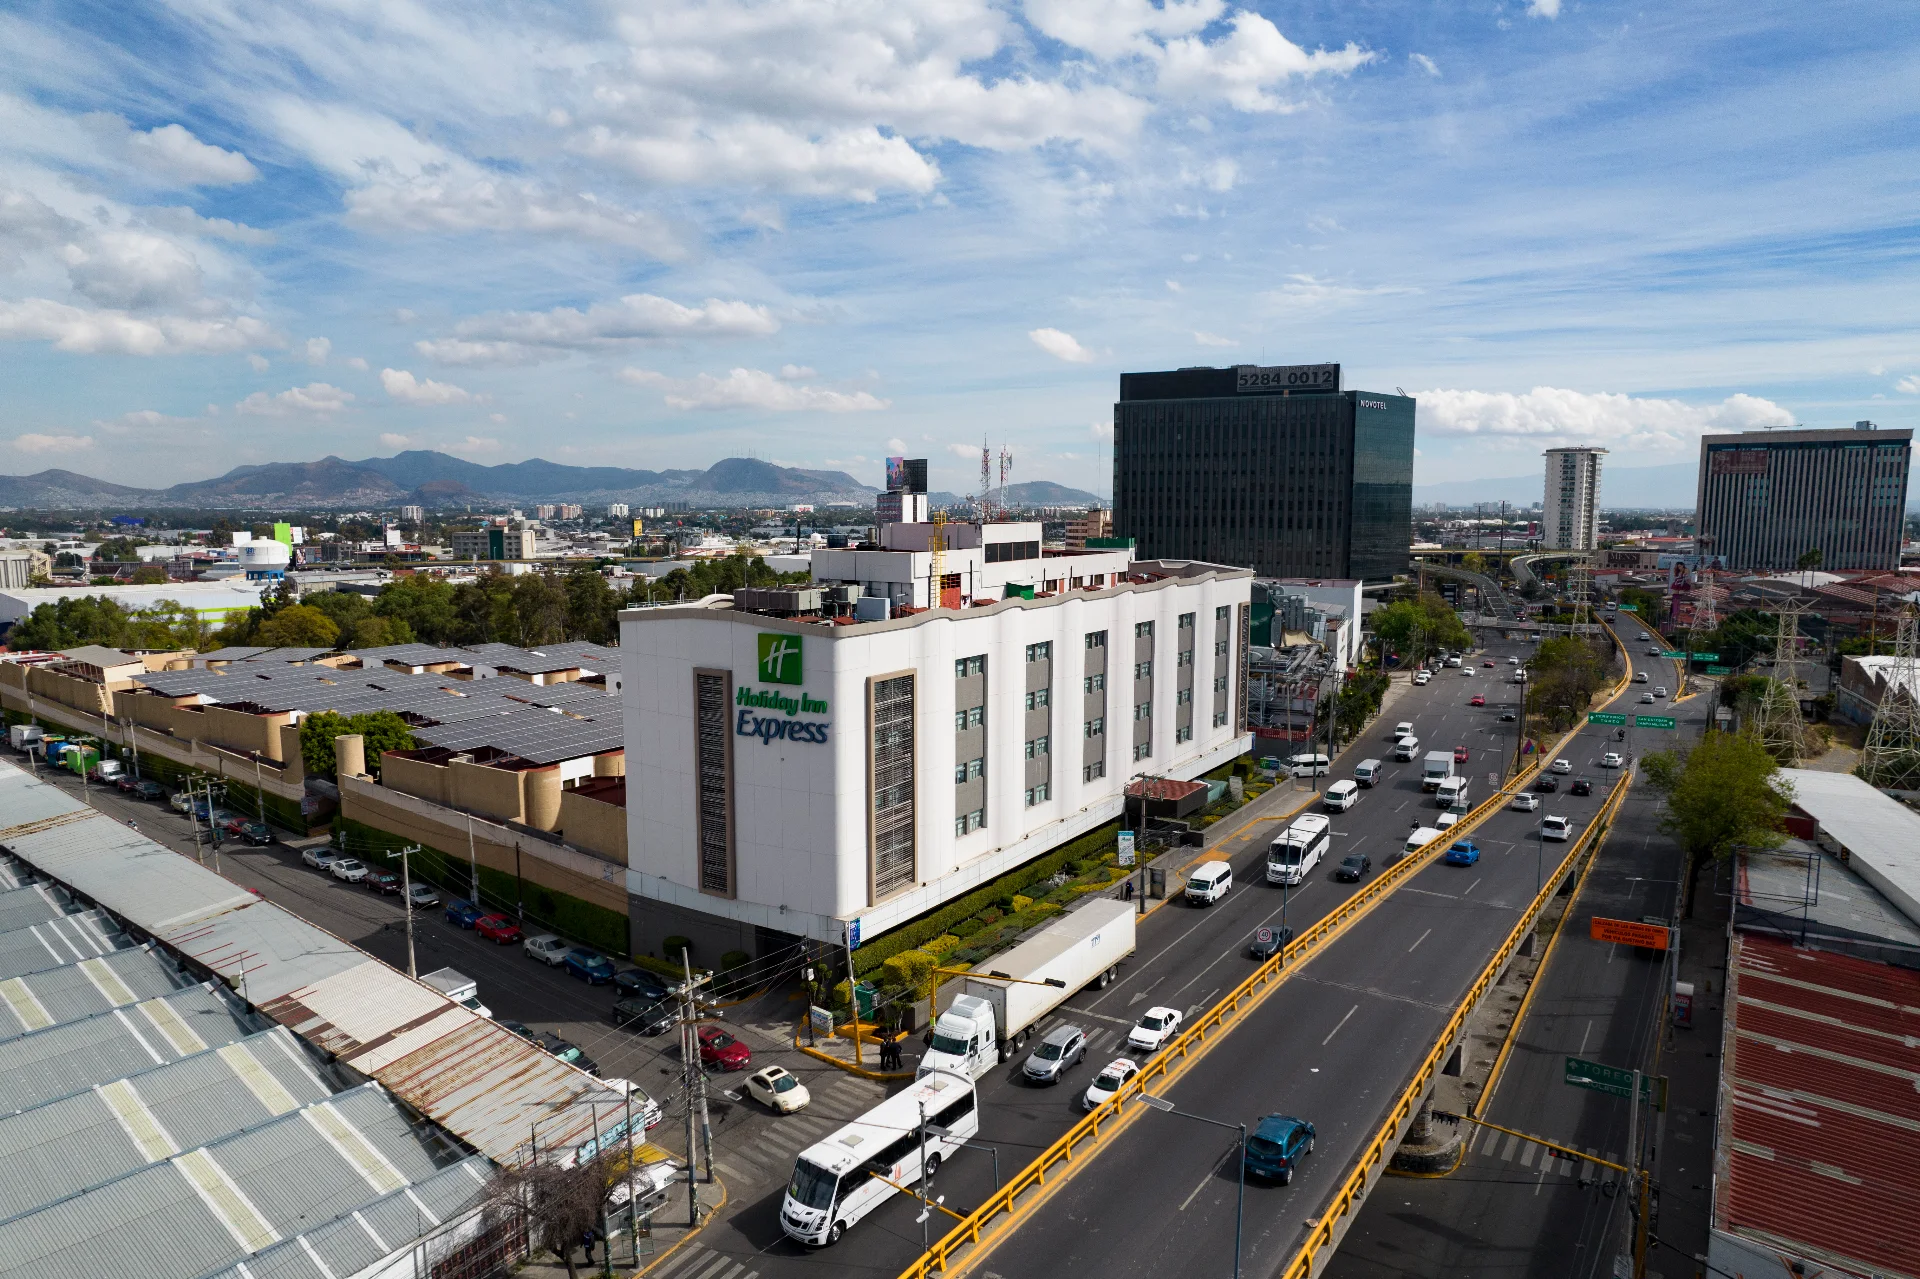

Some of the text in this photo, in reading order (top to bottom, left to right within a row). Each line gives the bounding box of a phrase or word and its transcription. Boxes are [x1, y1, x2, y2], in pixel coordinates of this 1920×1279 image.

[1239, 371, 1332, 386] 5284 0012
[1360, 400, 1386, 410] NOVOTEL
[736, 687, 828, 716] Holiday Inn
[736, 709, 828, 745] Express
[1622, 936, 1644, 944] GUSTAVO
[1582, 1063, 1632, 1082] TOREO
